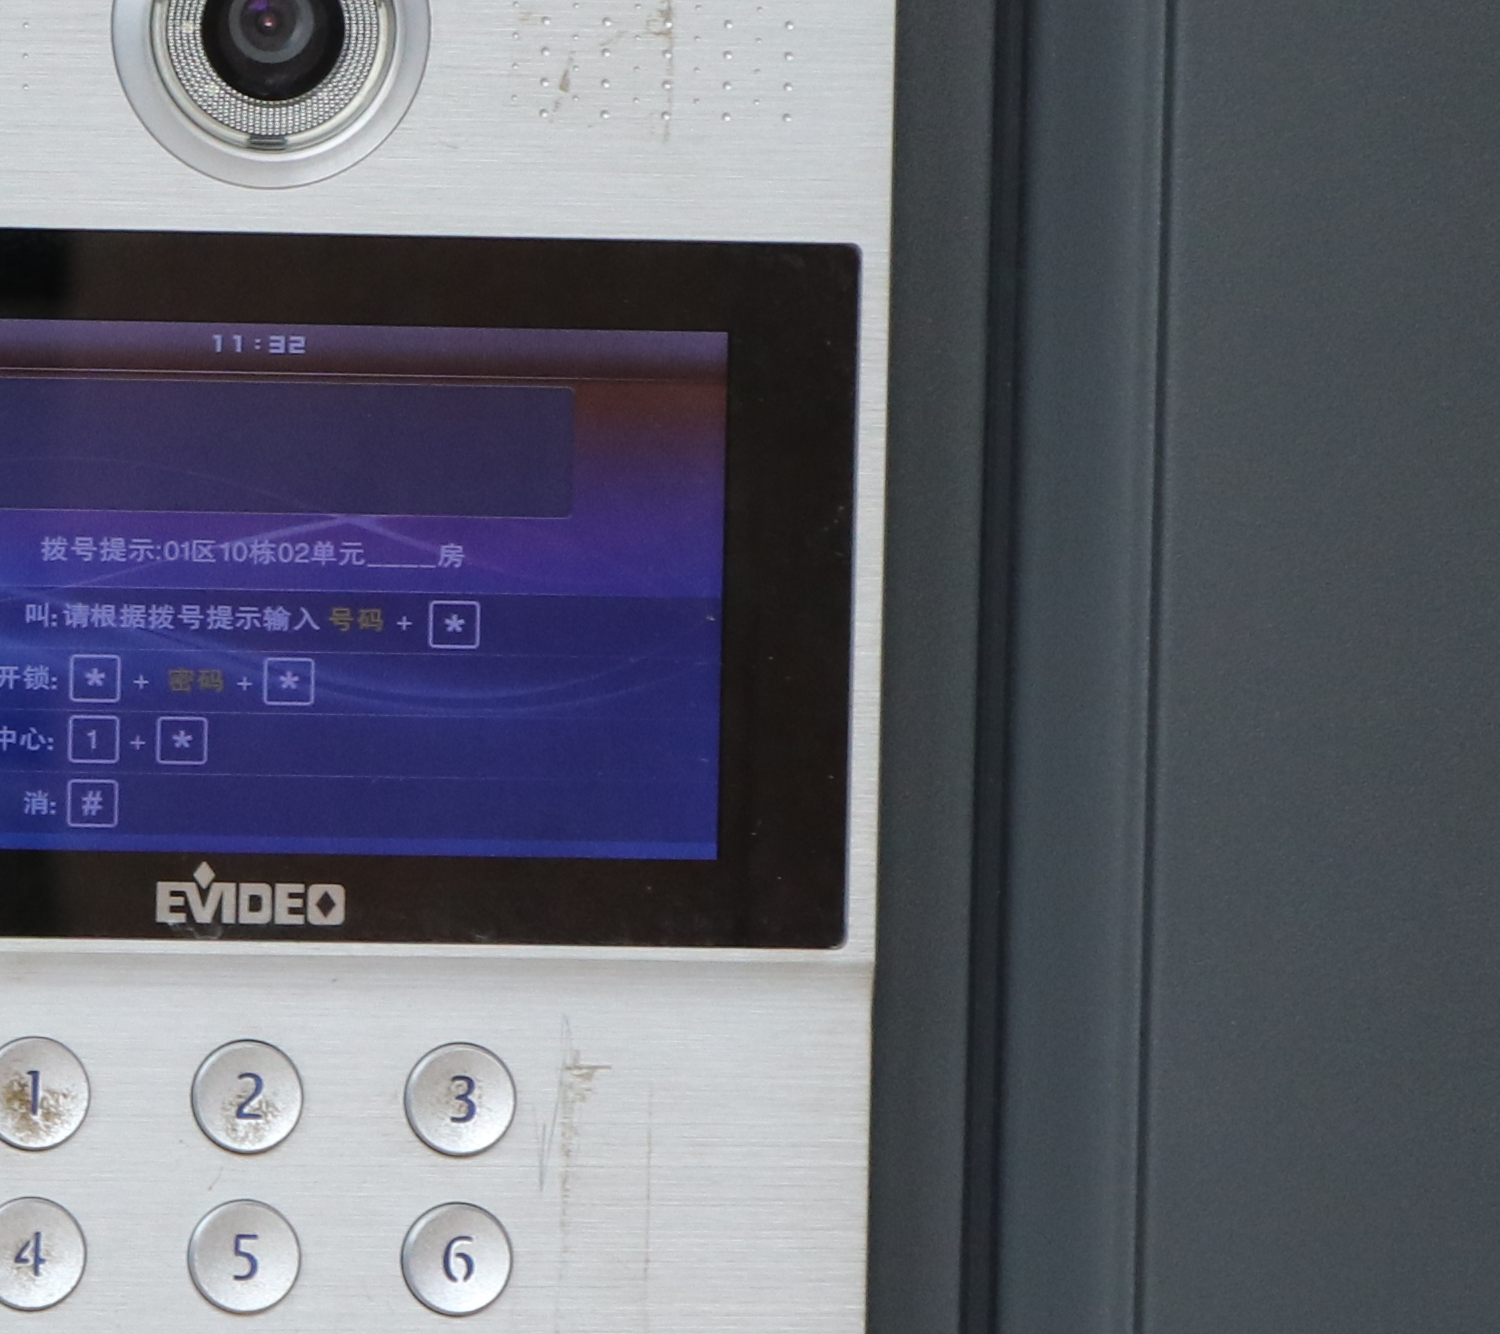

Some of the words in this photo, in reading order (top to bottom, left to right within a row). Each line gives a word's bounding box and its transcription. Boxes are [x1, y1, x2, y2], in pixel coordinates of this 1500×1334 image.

[212, 333, 306, 354] 11:32
[329, 607, 385, 633] 号码
[168, 668, 225, 694] 密码
[156, 879, 345, 926] EVIDEO
[25, 1069, 41, 1117] 1
[234, 1072, 265, 1120] 2
[449, 1075, 477, 1123] 3
[14, 1231, 46, 1277] 4
[232, 1233, 260, 1281] 5
[442, 1235, 475, 1283] 6
